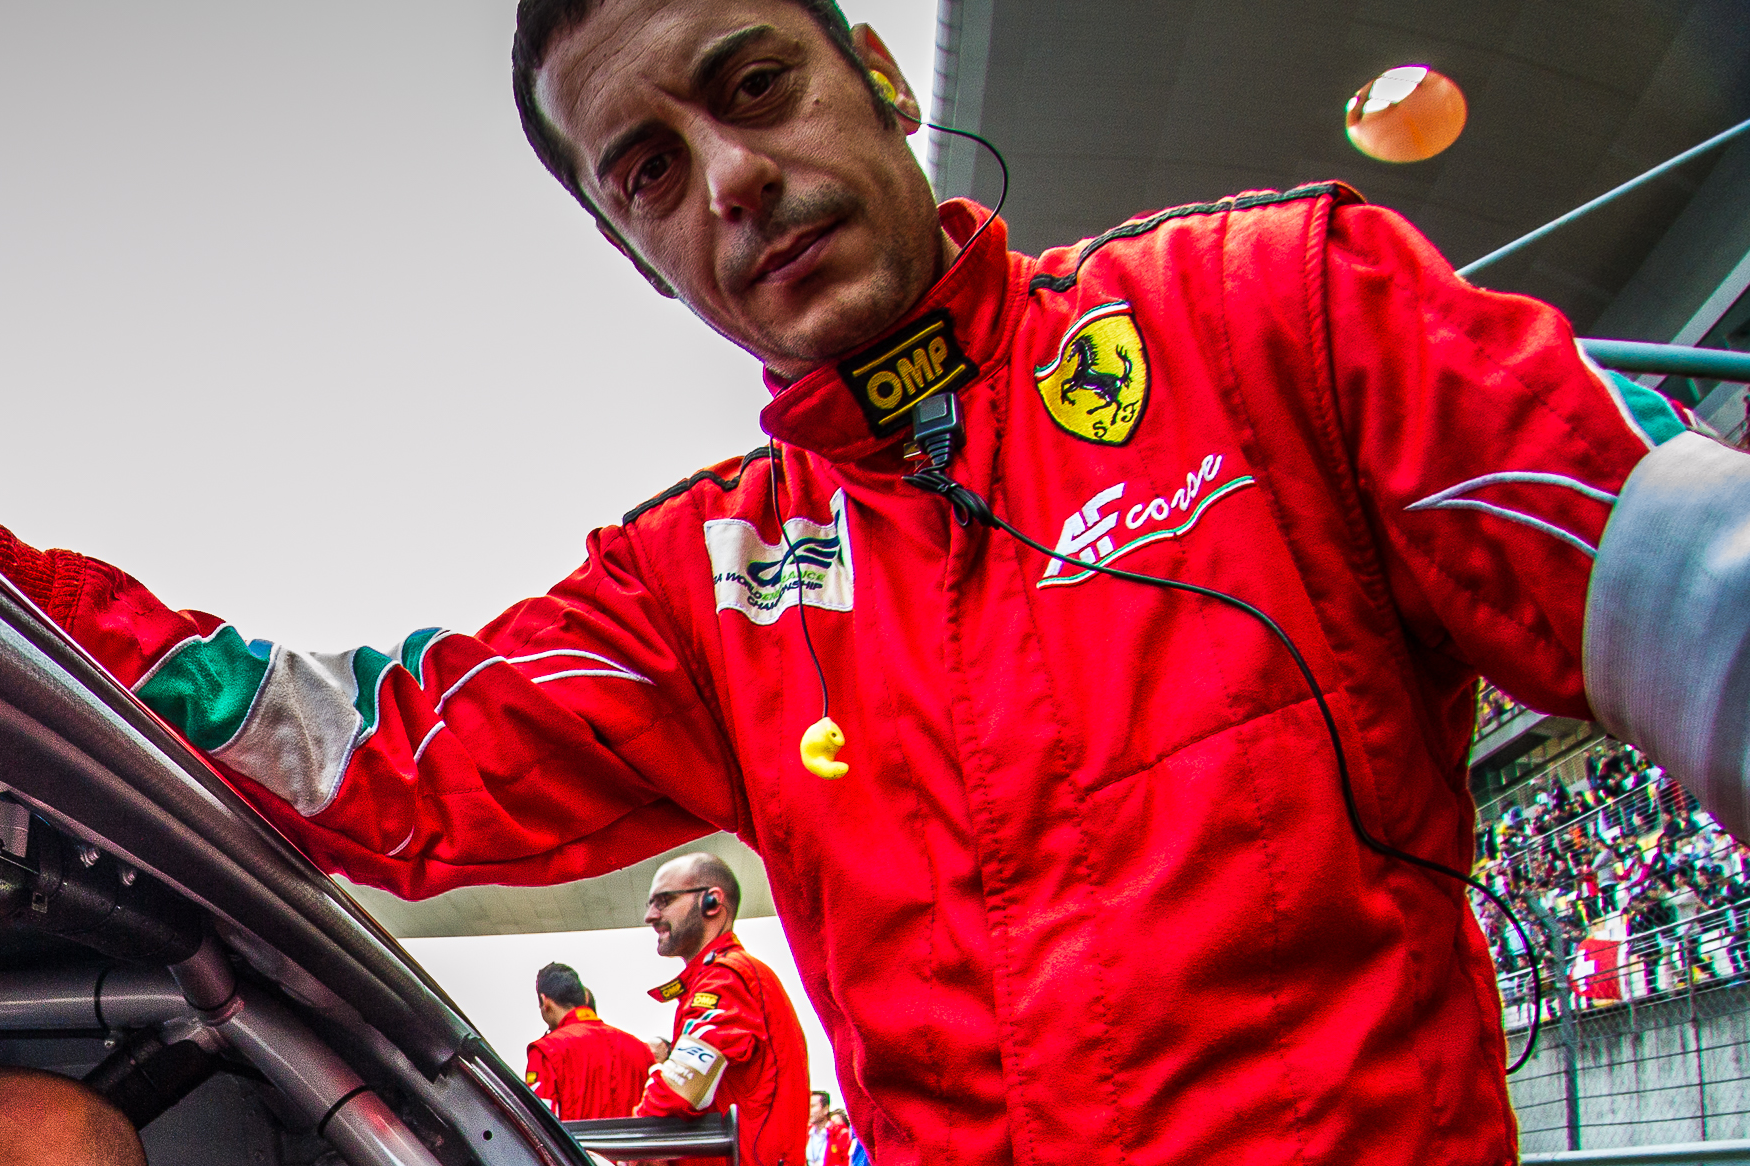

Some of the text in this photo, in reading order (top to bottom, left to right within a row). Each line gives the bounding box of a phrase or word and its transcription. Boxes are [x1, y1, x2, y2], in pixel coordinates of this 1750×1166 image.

[866, 336, 949, 410] OMP
[1092, 401, 1140, 438] S F
[1042, 453, 1225, 579] AF corse
[725, 572, 762, 599] WORLD
[693, 996, 718, 1006] OMP
